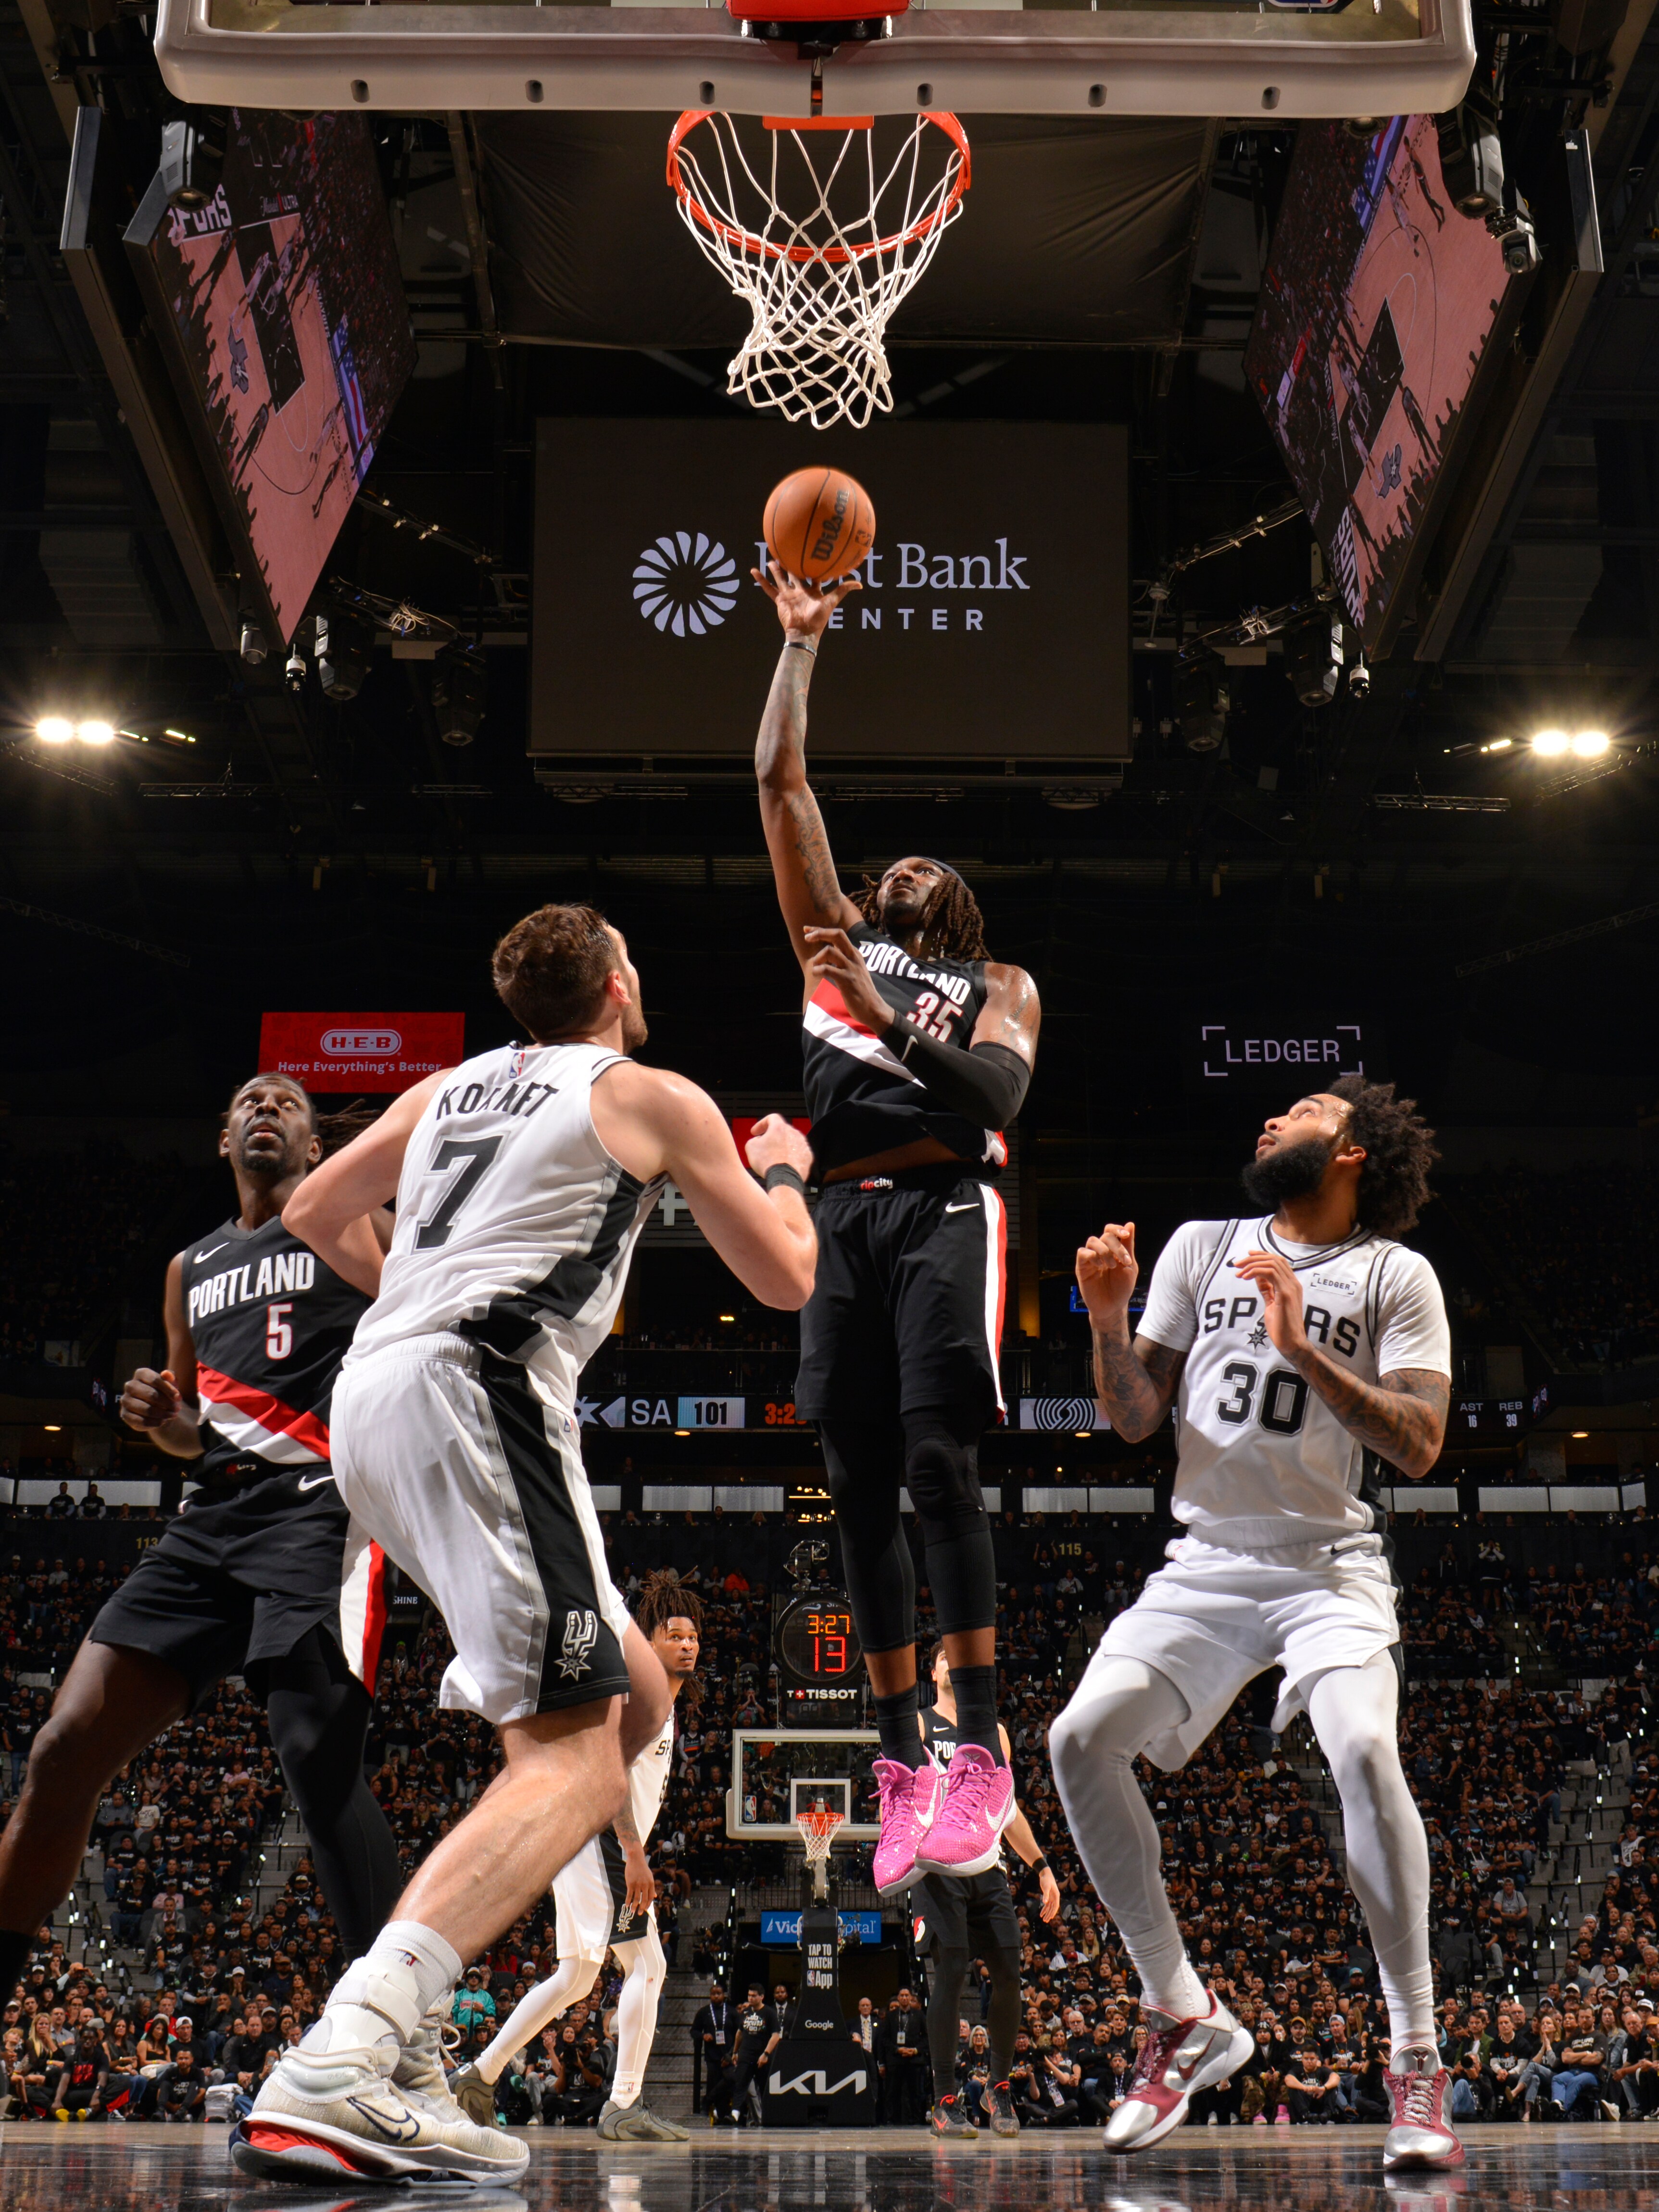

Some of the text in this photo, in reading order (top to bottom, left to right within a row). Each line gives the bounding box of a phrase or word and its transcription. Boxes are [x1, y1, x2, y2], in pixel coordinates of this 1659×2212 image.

[282, 195, 299, 210] ULTRA
[812, 489, 850, 561] Wilson
[896, 537, 1031, 590] Bank
[828, 608, 984, 630] ENTER
[906, 992, 965, 1043] 35
[1225, 1039, 1340, 1063] LEDGER
[278, 1061, 441, 1075] Here Everything's Better
[412, 1131, 509, 1254] 7
[188, 1252, 314, 1328] PORTLAND
[1317, 1278, 1350, 1291] LEDGER
[266, 1303, 293, 1360] 5
[1204, 1297, 1360, 1358] SPRS
[1216, 1360, 1308, 1436] 30
[1460, 1401, 1523, 1412] AST REB
[631, 1399, 671, 1425] SA
[694, 1402, 728, 1425] 101
[765, 1403, 807, 1425] 3:2
[1468, 1414, 1517, 1428] 16 39
[136, 1537, 158, 1549] 113
[1059, 1543, 1082, 1556] 115
[393, 1596, 418, 1604] SHINE
[808, 1615, 850, 1634] 3:27
[815, 1636, 846, 1672] 13
[806, 1689, 857, 1699] TISSOT
[808, 1944, 832, 1956] TAP TO
[808, 1957, 832, 1969] WATCH
[815, 1971, 832, 1989] App
[805, 2020, 834, 2030] Google
